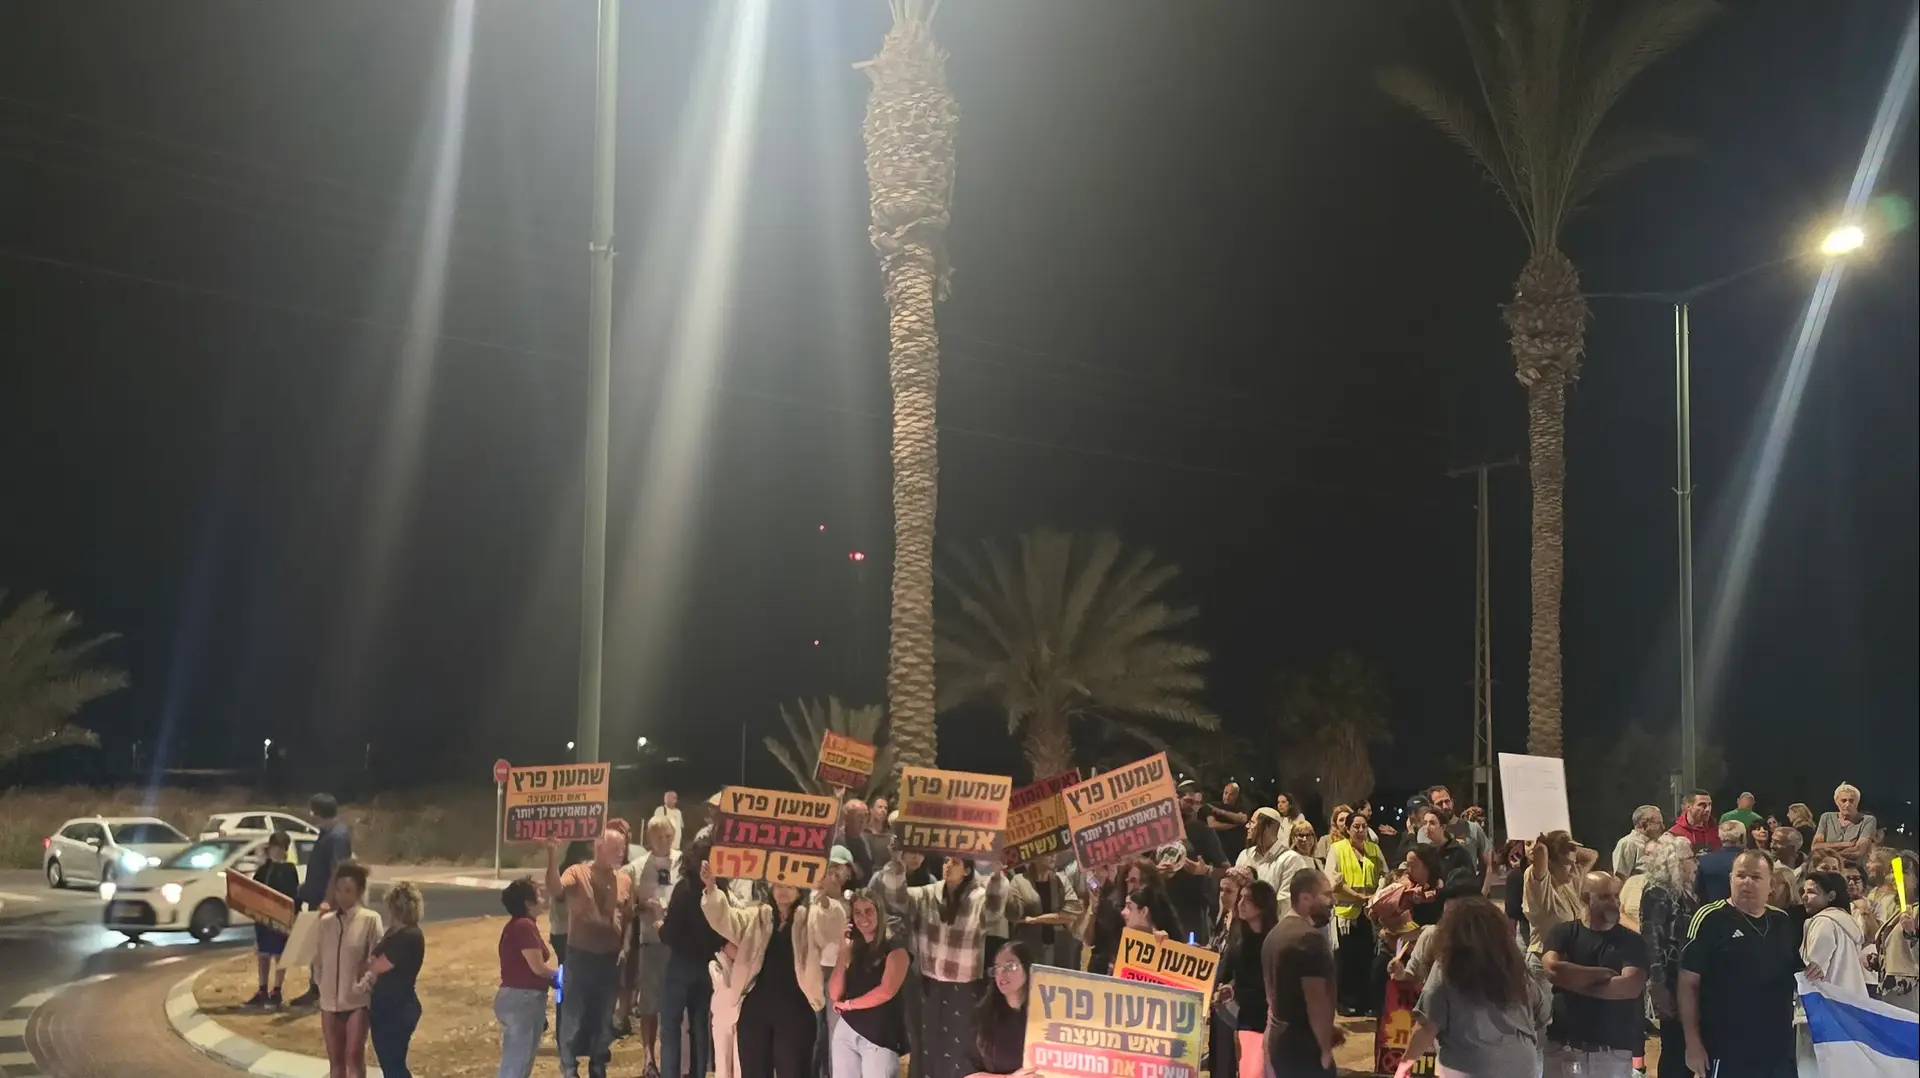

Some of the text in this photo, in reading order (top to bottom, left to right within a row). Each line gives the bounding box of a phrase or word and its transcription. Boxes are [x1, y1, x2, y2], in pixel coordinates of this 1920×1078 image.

[512, 767, 605, 792] שמעון פרץ
[907, 774, 1008, 802] שמעון פרץ
[1066, 759, 1164, 813] שמעון פרץ
[512, 803, 602, 820] לא מאמינים לך יותר,
[526, 792, 587, 804] ראש המועצה
[732, 792, 831, 818] שמעון פרץ
[1090, 793, 1152, 822] ראש המועצה
[1158, 800, 1173, 817] לא
[515, 817, 598, 838] לך הביתה!
[1104, 820, 1116, 836] לך
[1117, 808, 1158, 831] מאמינים
[1151, 817, 1175, 840] לך
[723, 819, 828, 849] אכזבת!
[903, 825, 996, 851] אכזבה!
[1020, 833, 1058, 860] עשיה
[1086, 825, 1150, 862] הביתה!
[715, 850, 820, 884] די! לך!
[1124, 937, 1155, 964] פרץ
[1157, 947, 1215, 981] שמעון
[1037, 984, 1195, 1034] שמעון פרץ
[1059, 1026, 1172, 1056] ראש מועצה
[1035, 1047, 1108, 1074] התושבים
[1111, 1058, 1136, 1077] את
